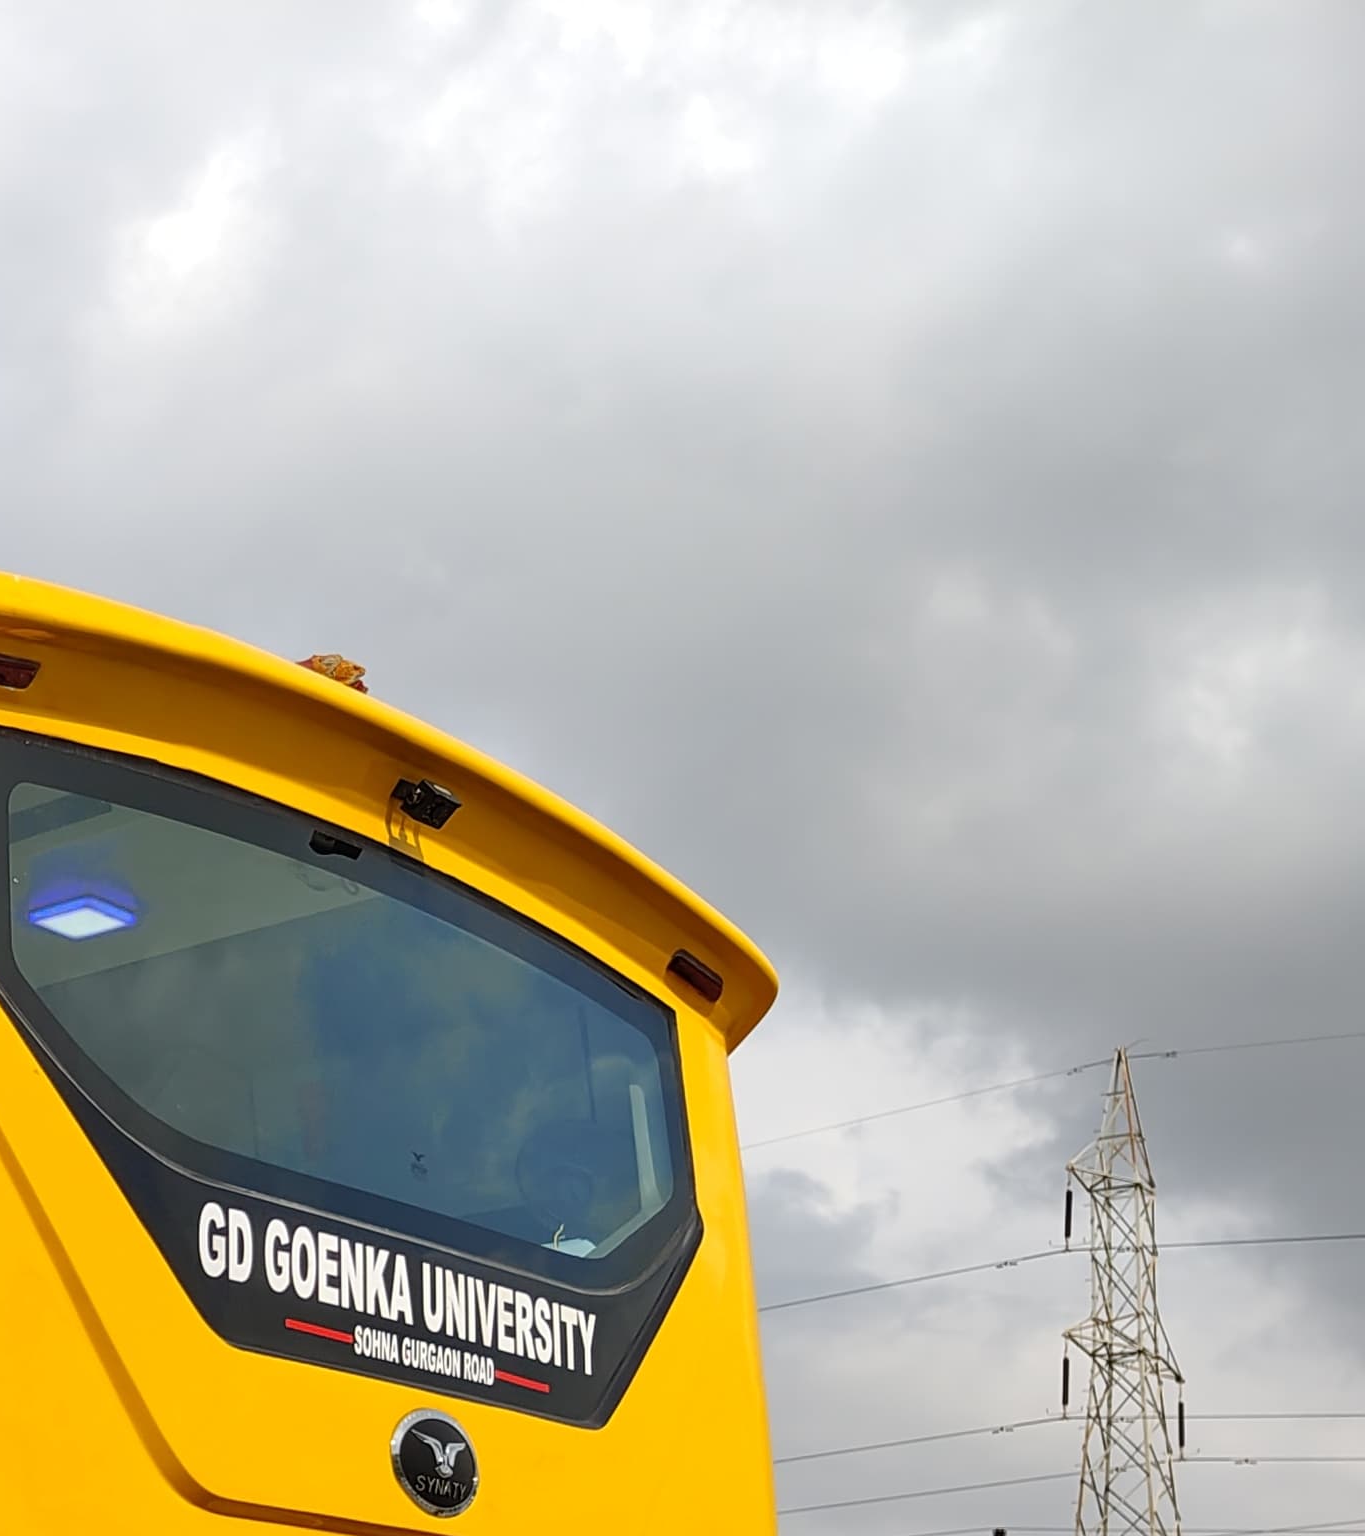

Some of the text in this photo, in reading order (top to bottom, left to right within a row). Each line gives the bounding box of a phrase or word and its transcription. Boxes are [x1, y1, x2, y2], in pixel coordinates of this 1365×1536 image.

[197, 1201, 597, 1376] GD GOENKA UNIVERSITY
[354, 1325, 495, 1386] SOHNA GURGAON ROAD
[415, 1474, 467, 1500] SYNATY
